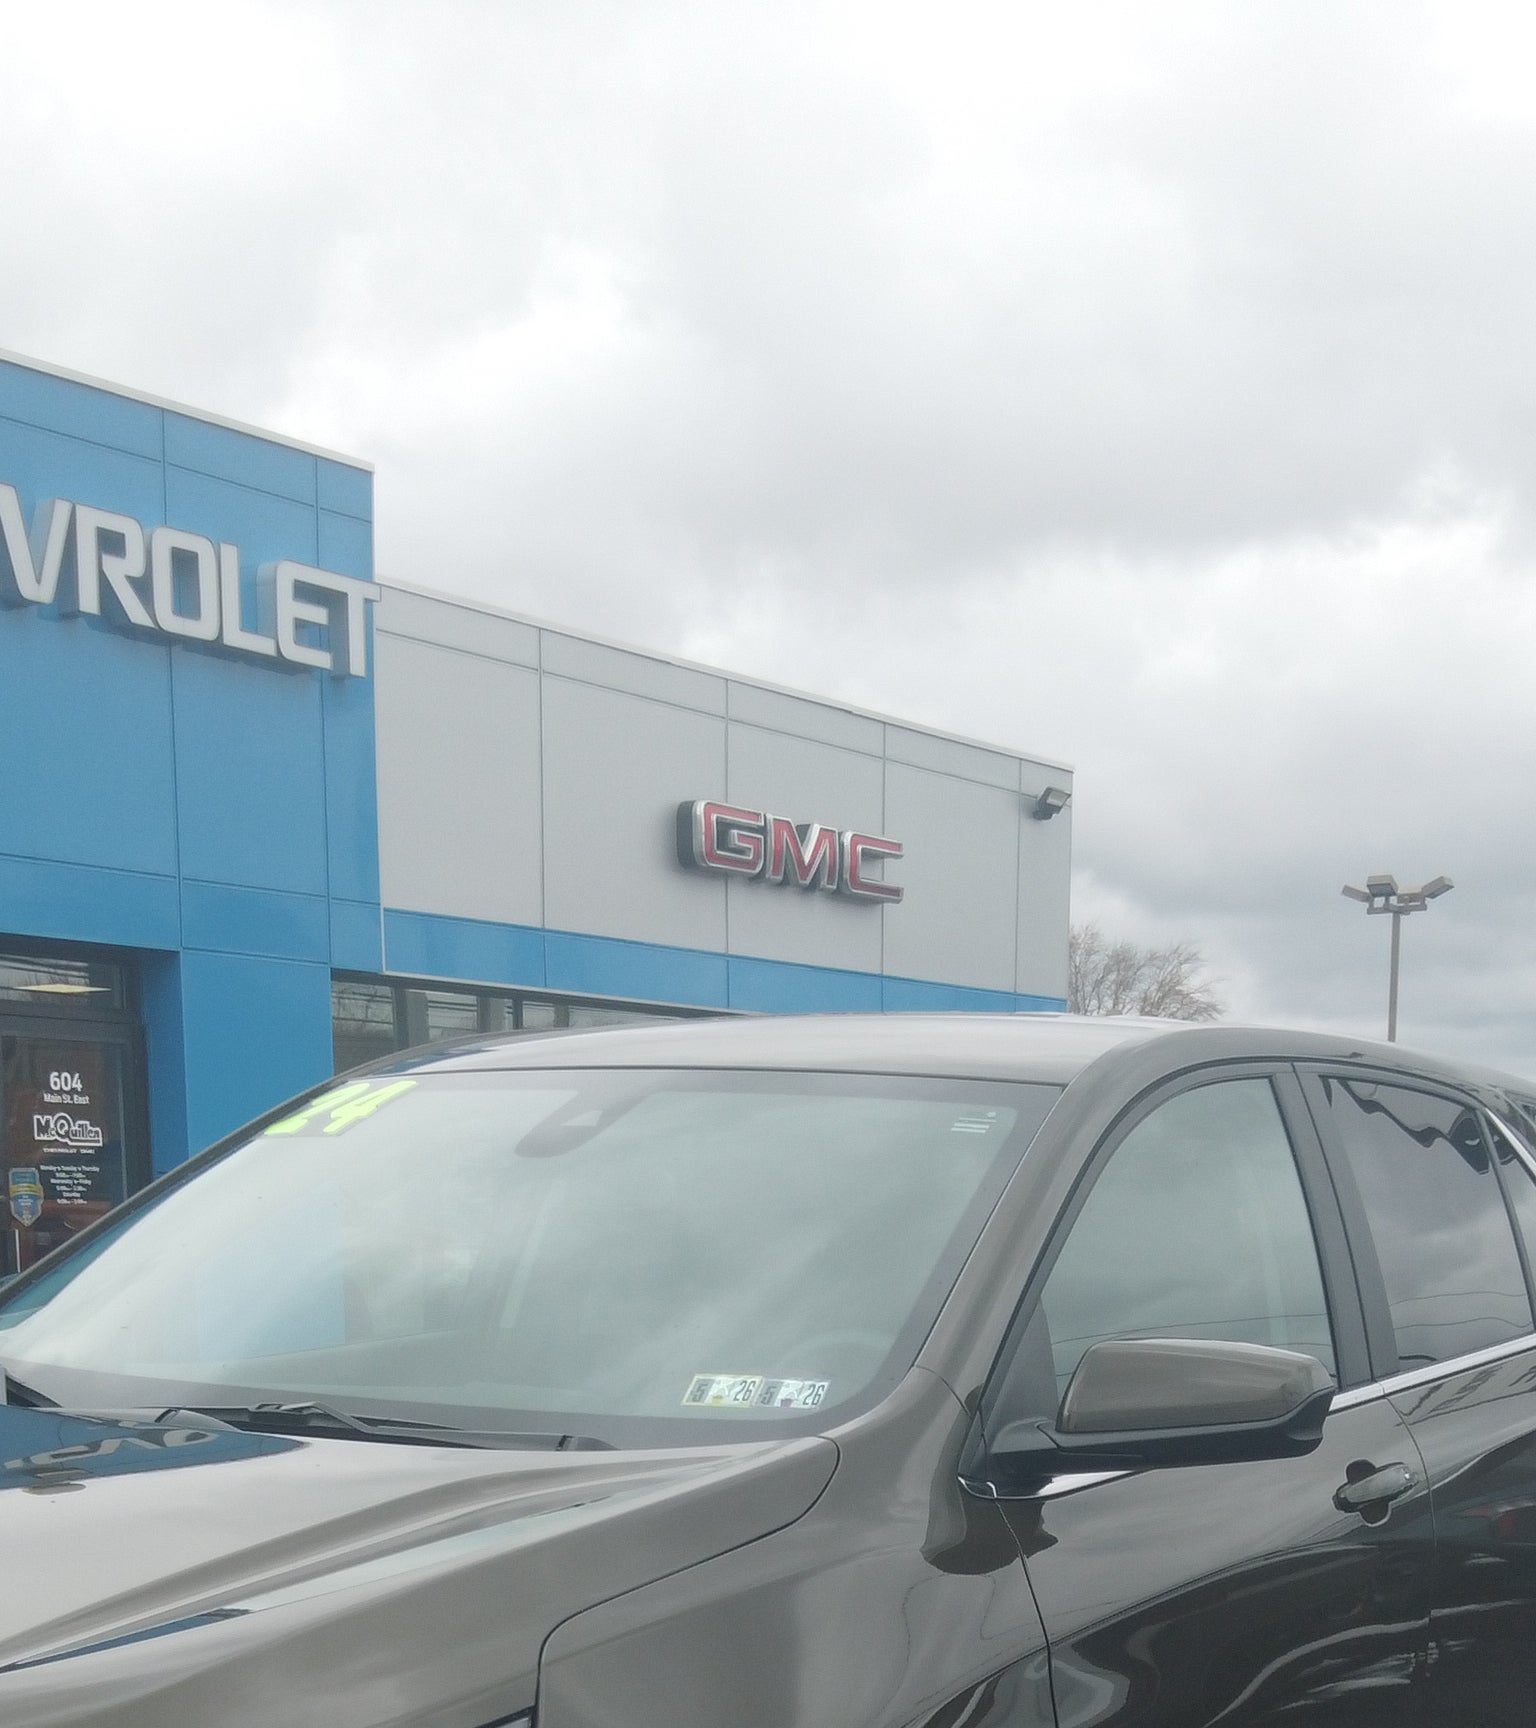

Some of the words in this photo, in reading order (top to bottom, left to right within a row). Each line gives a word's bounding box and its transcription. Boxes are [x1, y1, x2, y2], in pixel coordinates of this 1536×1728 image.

[676, 800, 905, 904] GMC
[49, 1071, 83, 1092] 604
[43, 1093, 62, 1104] Main
[73, 1095, 90, 1105] East
[733, 1379, 757, 1402] 26
[802, 1383, 826, 1407] 26
